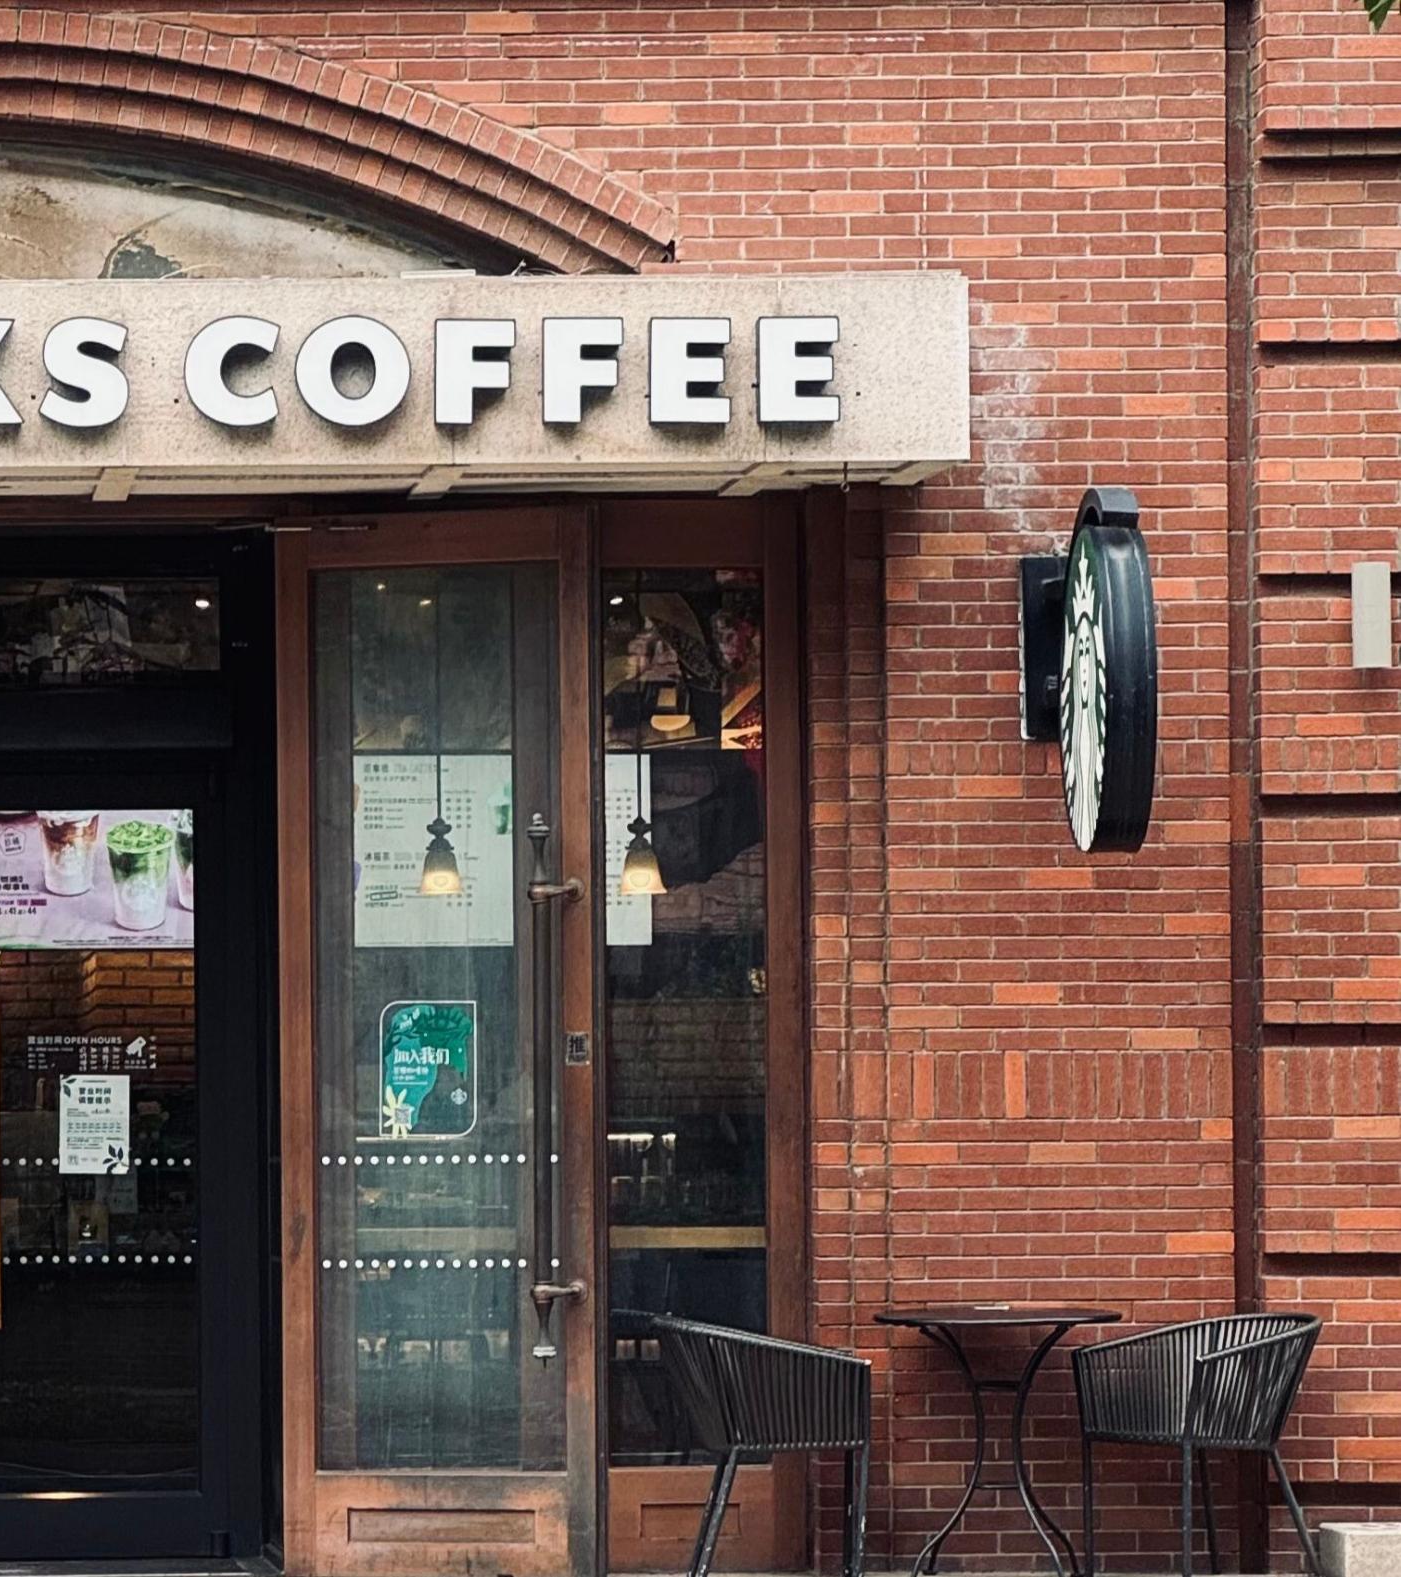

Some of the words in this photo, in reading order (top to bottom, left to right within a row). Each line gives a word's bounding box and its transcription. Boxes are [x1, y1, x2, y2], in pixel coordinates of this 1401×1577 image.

[184, 315, 841, 427] COFFEE
[63, 1036, 88, 1044] OPEN
[90, 1036, 123, 1044] HOURS
[393, 1046, 450, 1065] 加入我们
